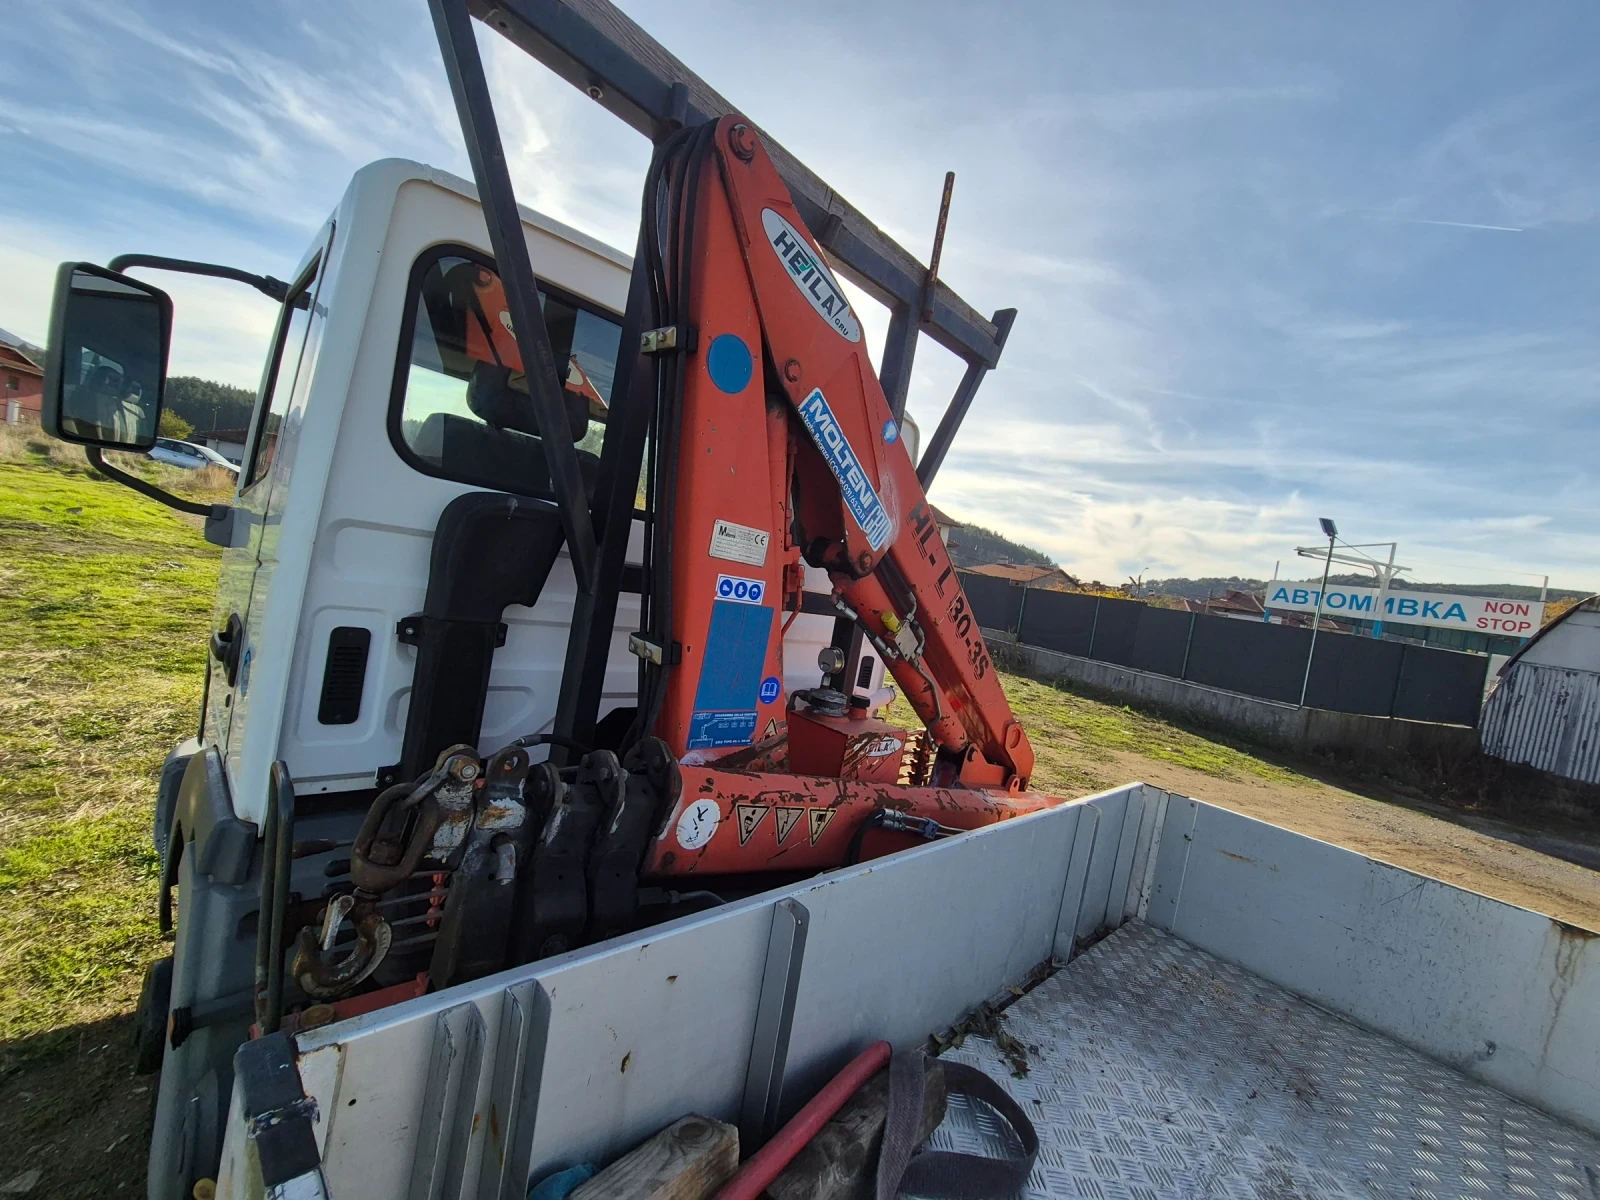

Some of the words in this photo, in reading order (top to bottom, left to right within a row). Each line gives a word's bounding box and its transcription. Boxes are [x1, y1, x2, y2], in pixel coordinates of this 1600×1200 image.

[773, 230, 833, 317] HEILA
[834, 318, 849, 336] GRU
[809, 398, 873, 508] MOLTENI
[1271, 587, 1468, 622] АВТОМИВКА
[1484, 601, 1530, 617] NON
[1476, 617, 1531, 633] STOP
